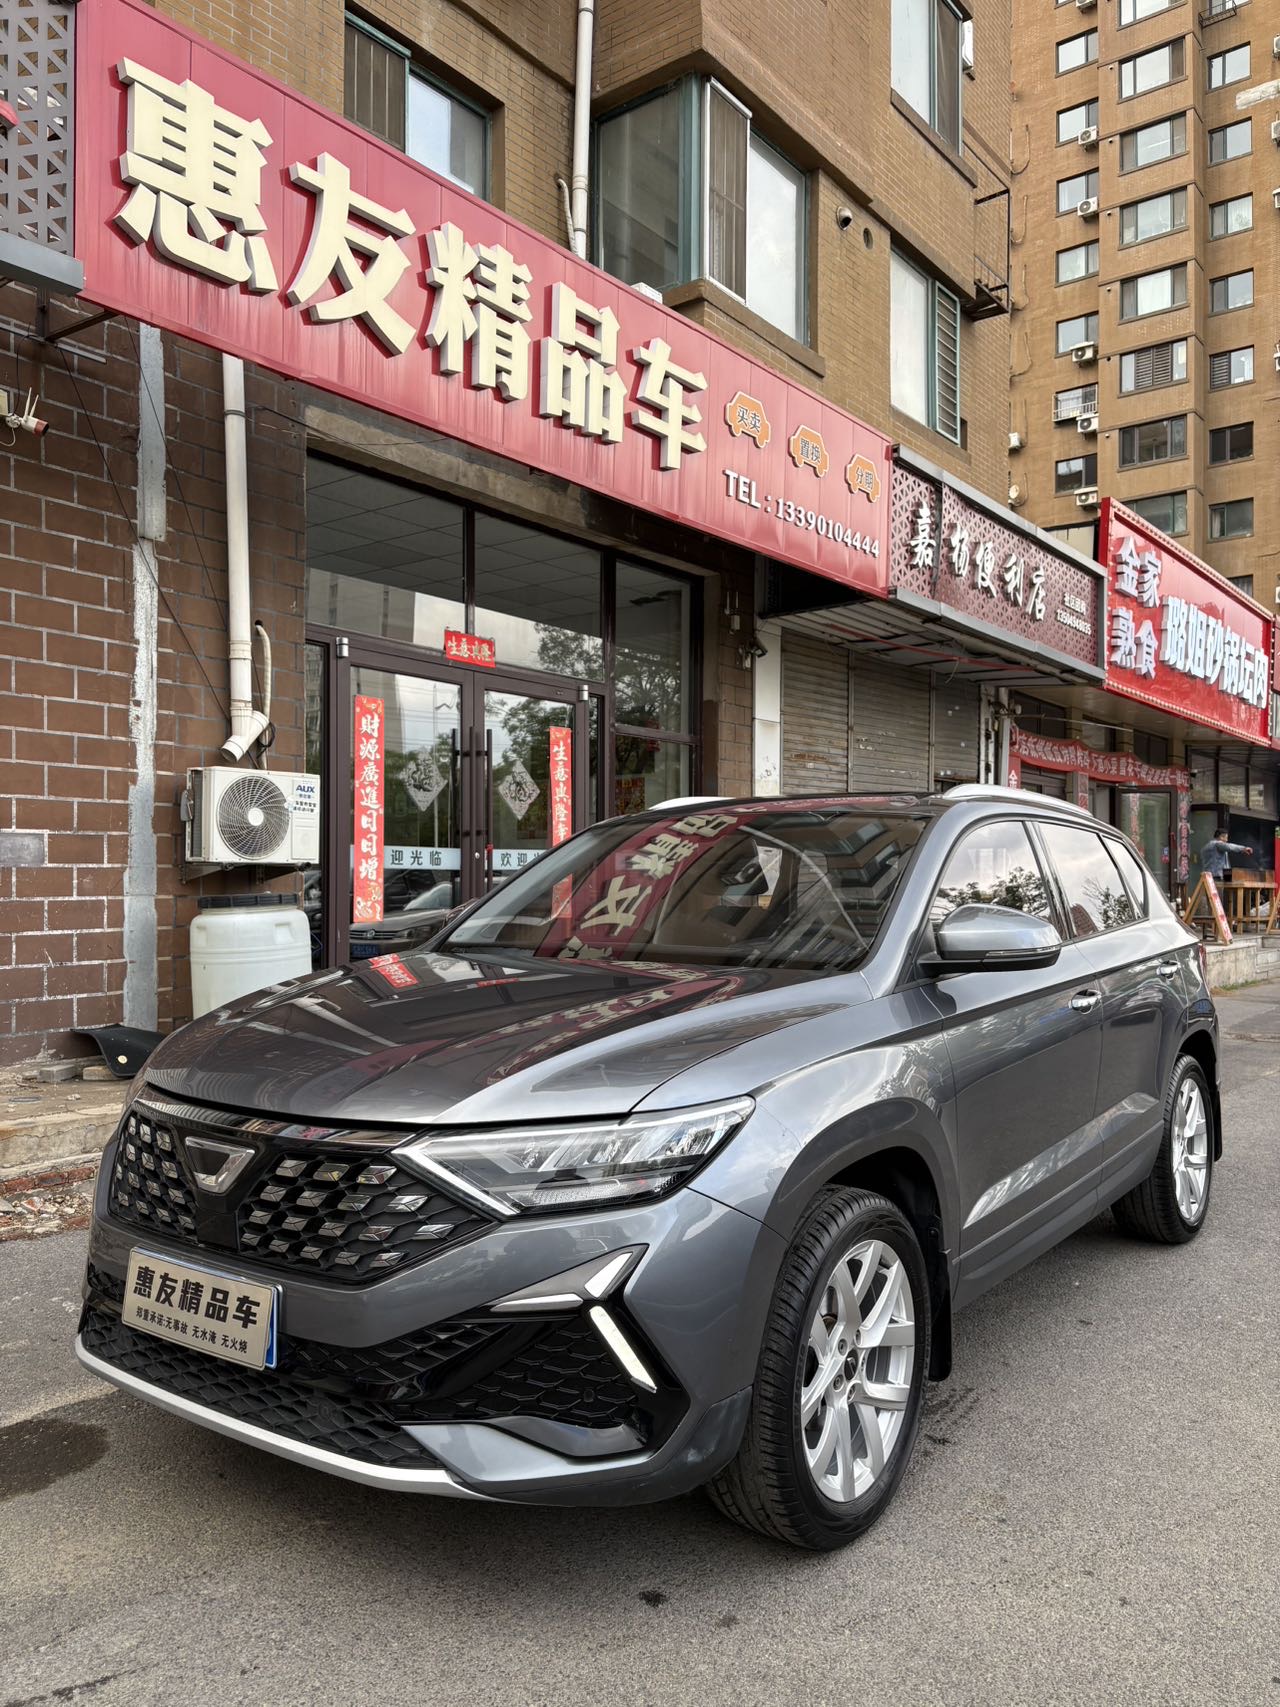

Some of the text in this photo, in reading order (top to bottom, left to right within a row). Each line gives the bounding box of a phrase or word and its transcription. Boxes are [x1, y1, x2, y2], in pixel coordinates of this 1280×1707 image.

[114, 56, 707, 471] 惠友精品车
[737, 405, 762, 433] 买卖
[799, 438, 821, 464] 置换
[855, 467, 874, 491] 分期
[1111, 607, 1158, 680] 熟食
[296, 784, 315, 793] AUX
[500, 851, 542, 867] 欢迎
[133, 1265, 261, 1329] 惠友精品车
